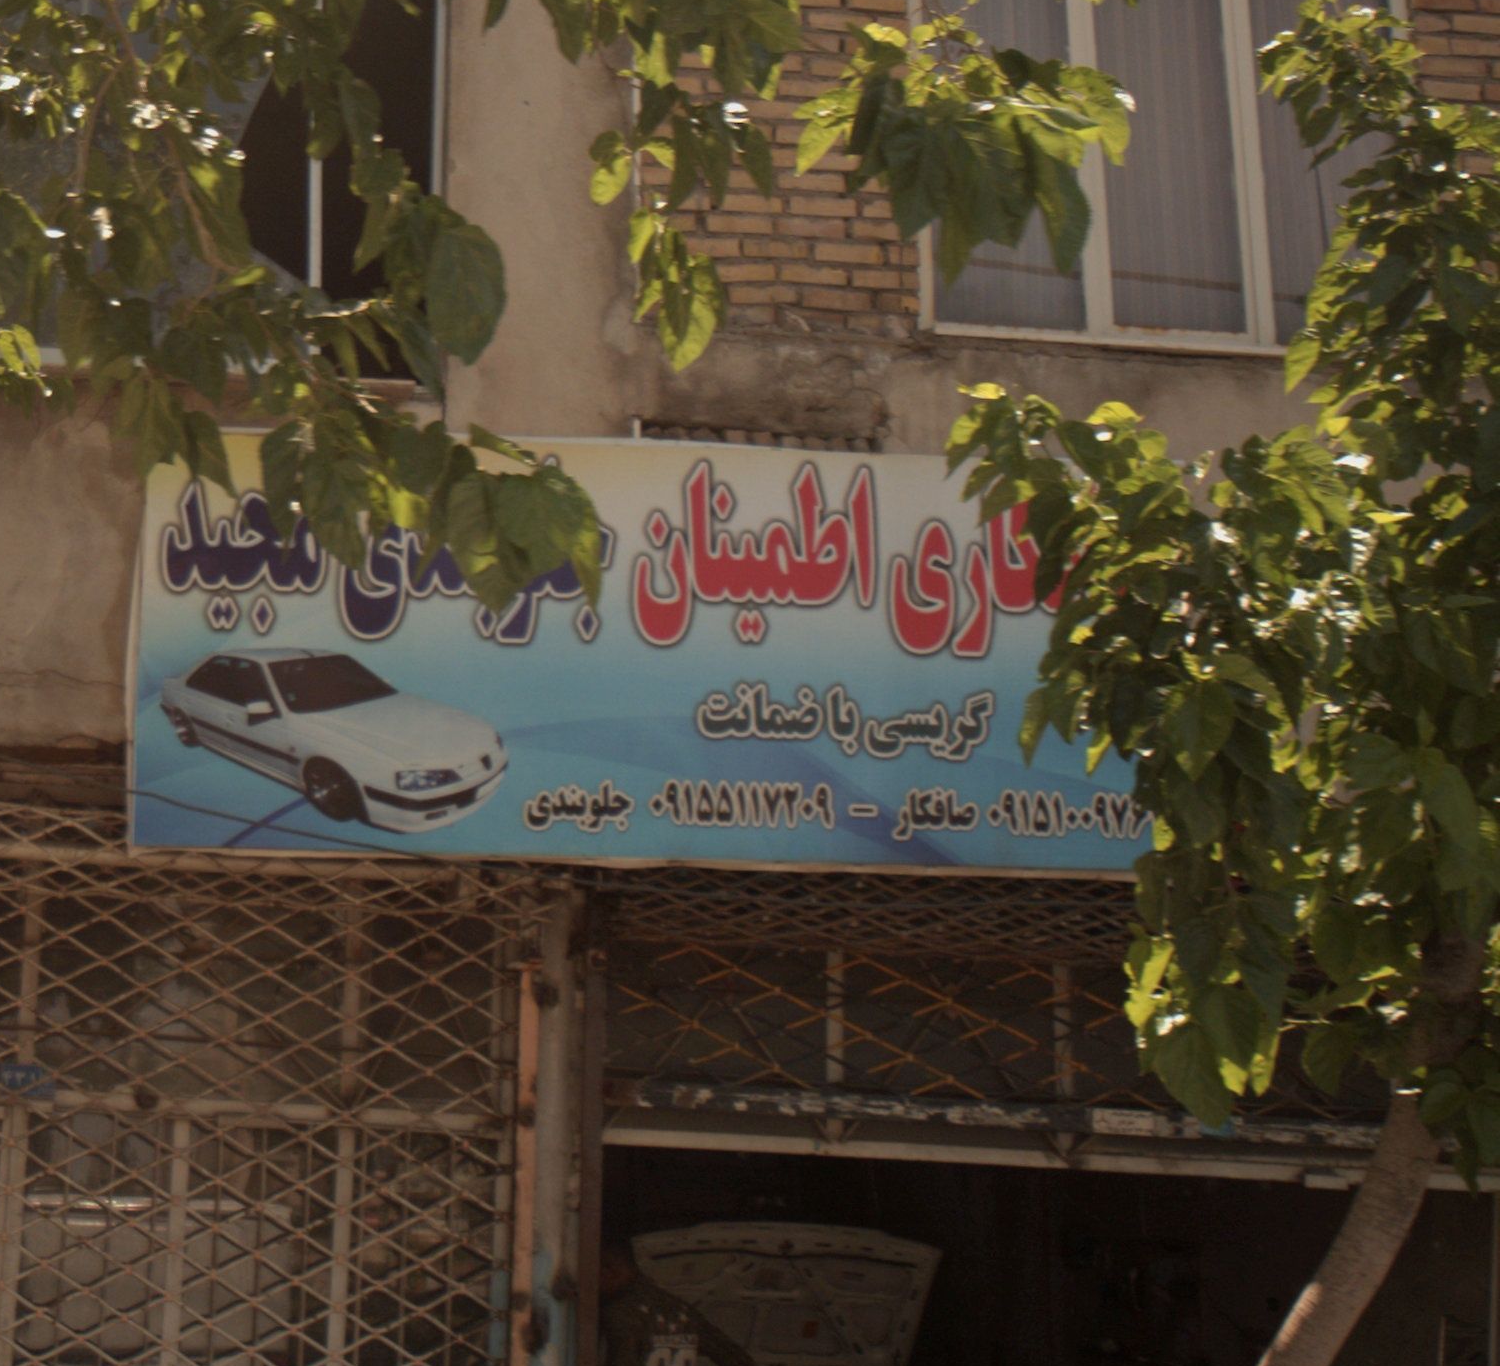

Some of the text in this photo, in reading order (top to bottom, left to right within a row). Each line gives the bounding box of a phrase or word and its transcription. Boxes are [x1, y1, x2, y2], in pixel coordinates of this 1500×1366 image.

[161, 480, 328, 635] مجید
[633, 458, 878, 647] اطمینان
[696, 679, 996, 761] گریسی با ضمانت
[524, 779, 634, 833] جلوبندی
[893, 788, 980, 841] صافکار
